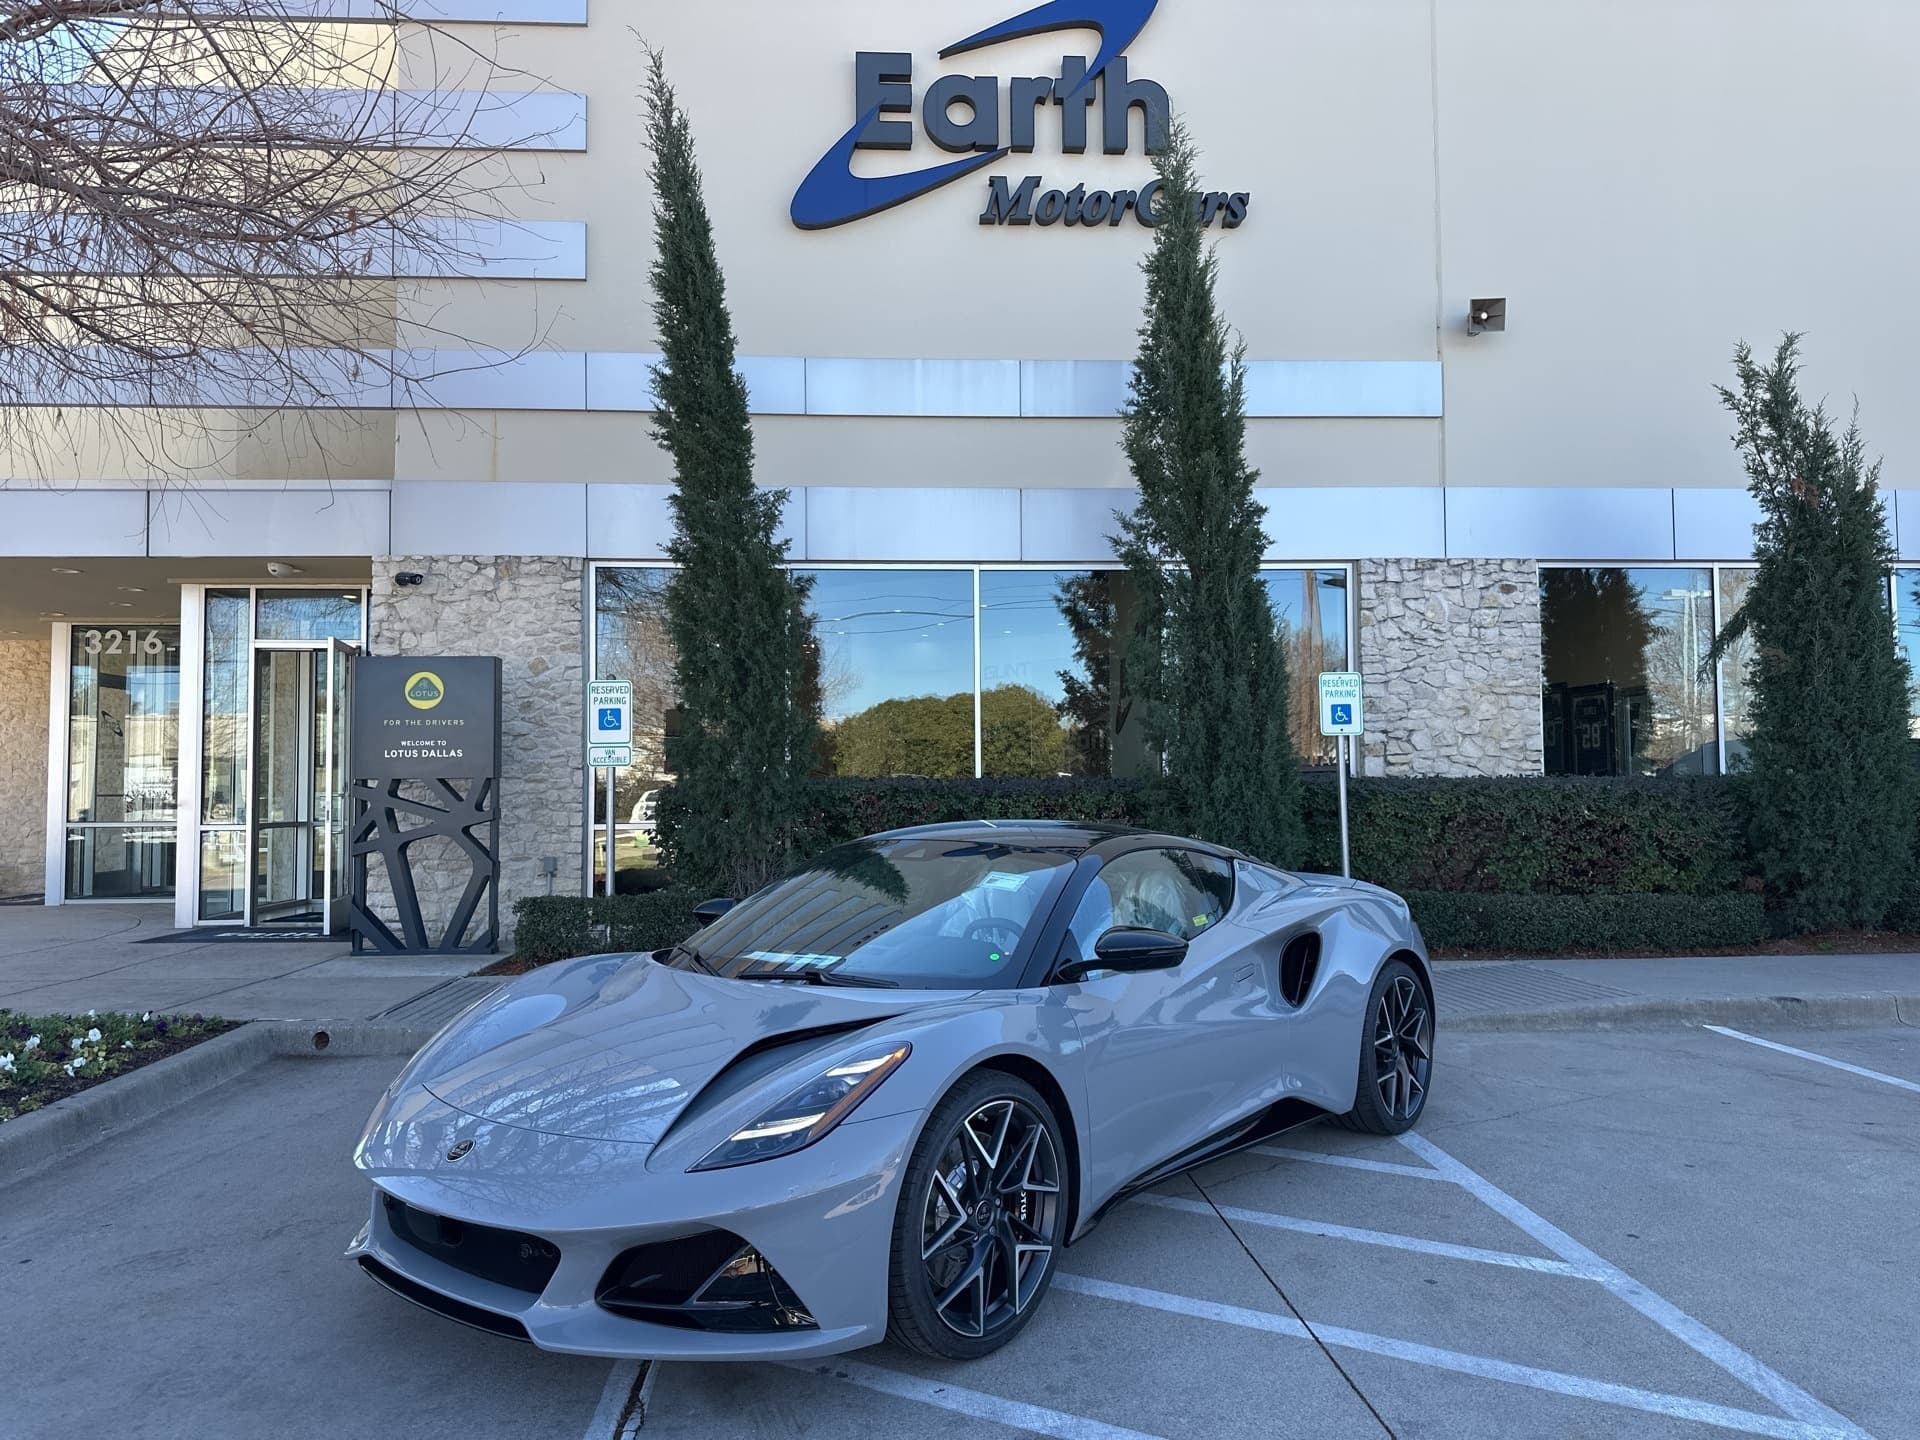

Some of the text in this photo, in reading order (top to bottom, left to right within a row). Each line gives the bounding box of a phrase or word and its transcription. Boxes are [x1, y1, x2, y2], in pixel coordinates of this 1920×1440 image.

[855, 51, 1170, 155] Earth
[1322, 679, 1359, 687] RESERVED
[591, 685, 630, 694] RESERVED
[1325, 689, 1357, 698] PARKING
[593, 697, 627, 705] PARKING
[384, 749, 463, 758] LOTUS DALLAS
[592, 756, 627, 764] ACCESSIBLE
